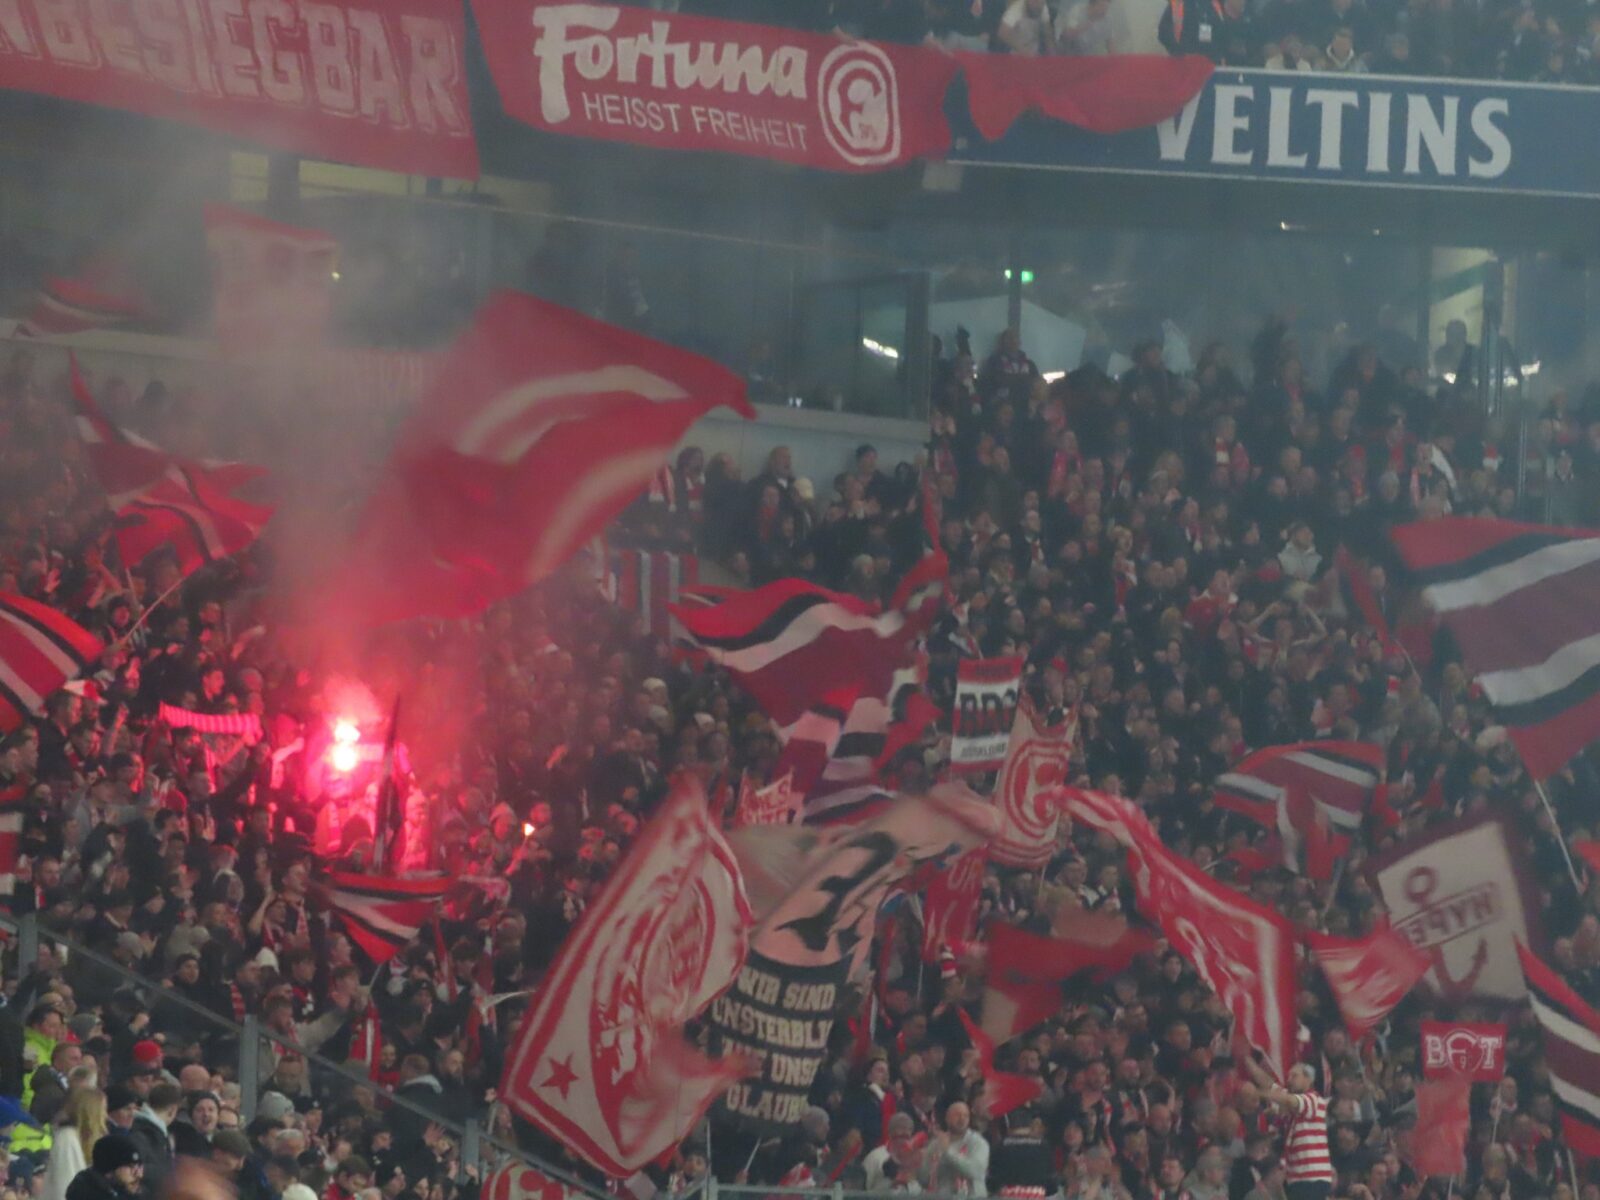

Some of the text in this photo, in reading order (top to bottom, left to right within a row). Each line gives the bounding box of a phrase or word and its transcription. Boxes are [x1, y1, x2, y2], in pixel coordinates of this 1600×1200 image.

[532, 4, 808, 124] Fortuna
[582, 91, 681, 134] HEISST
[691, 104, 808, 151] FREIHEIT
[1155, 84, 1513, 179] VELTINS
[771, 980, 837, 1012] SIND
